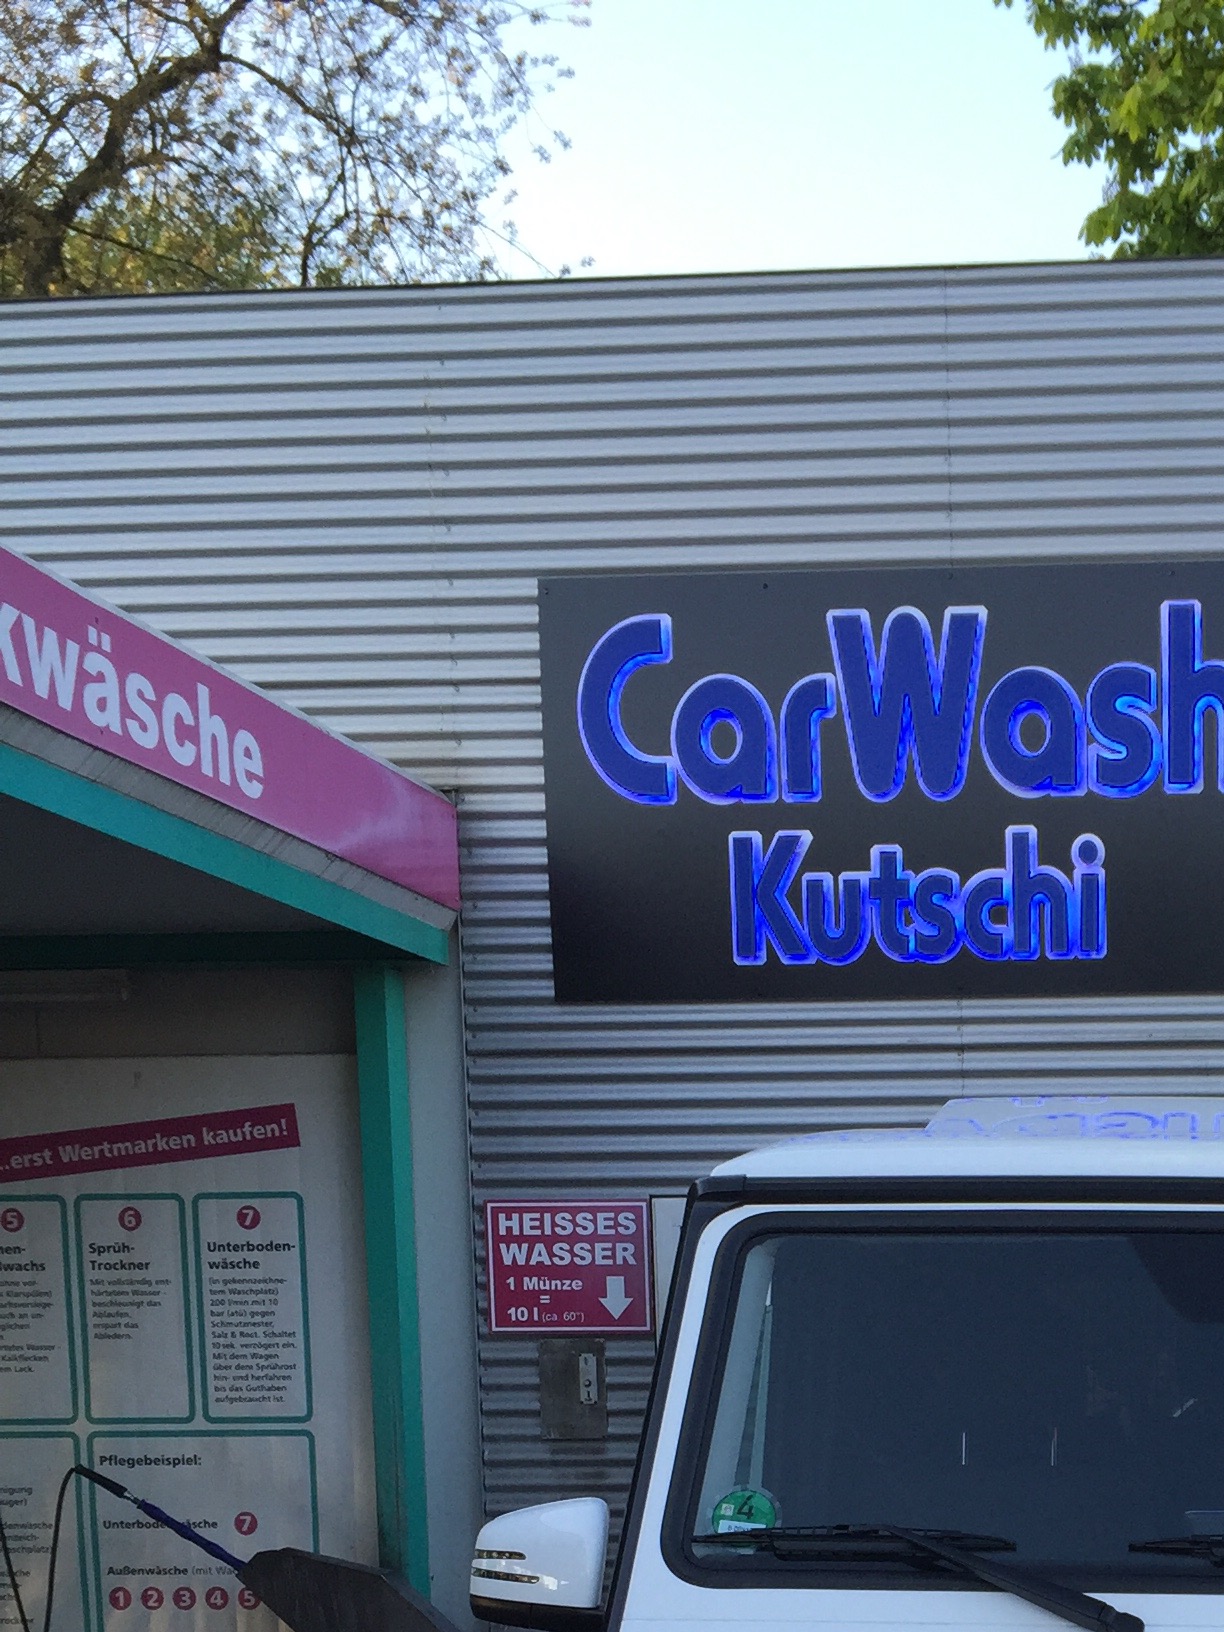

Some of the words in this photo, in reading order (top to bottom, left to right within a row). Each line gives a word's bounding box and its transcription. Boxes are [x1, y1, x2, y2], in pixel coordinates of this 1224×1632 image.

[728, 824, 1107, 966] Kutschi
[58, 1132, 196, 1164] Wertmarken
[202, 1118, 288, 1146] kaufen!
[498, 1211, 637, 1236] HEISSES
[88, 1242, 135, 1256] Sprüh-
[207, 1240, 296, 1252] Unterboden-
[500, 1242, 637, 1266] WASSER
[90, 1259, 150, 1272] Trockner
[207, 1258, 261, 1270] wäsche
[506, 1277, 515, 1291] 1
[523, 1276, 583, 1291] Münze
[507, 1307, 529, 1322] 10
[99, 1454, 202, 1468] Pflegebeispiel:
[736, 1494, 754, 1519] 4
[103, 1520, 218, 1530] Unterbodeäsche
[107, 1566, 189, 1576] Außenwäsche
